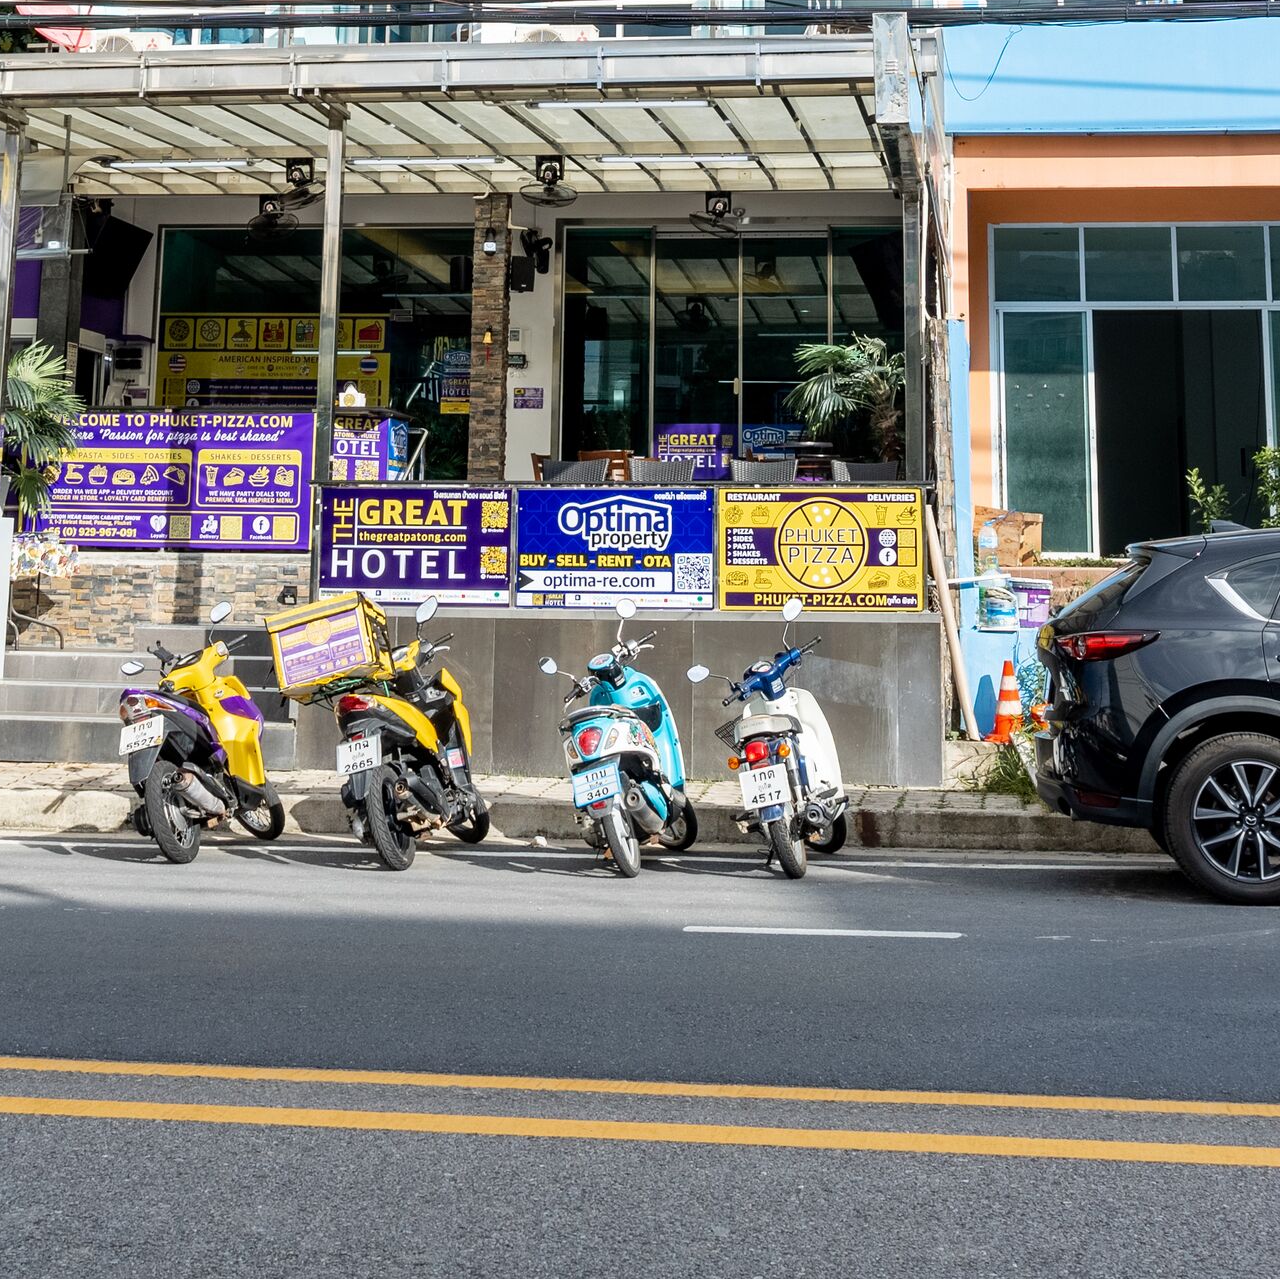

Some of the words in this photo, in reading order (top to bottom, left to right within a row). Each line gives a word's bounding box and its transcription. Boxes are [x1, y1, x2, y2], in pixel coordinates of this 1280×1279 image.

[263, 356, 301, 364] INSPIRED
[125, 414, 145, 427] TO
[150, 414, 293, 428] PHUKET-PIZZA.COM
[334, 417, 381, 431] GREAT
[145, 429, 165, 445] for
[166, 431, 198, 445] pizza
[200, 431, 211, 441] is
[214, 429, 237, 441] best
[670, 434, 716, 446] GREAT
[743, 430, 785, 442] Optima
[336, 440, 380, 455] OTEL
[658, 434, 668, 453] THE
[144, 452, 182, 460] TOASTIES
[727, 494, 781, 502] RESTAURANT
[867, 494, 915, 502] DELIVERIES
[359, 499, 468, 526] GREAT
[332, 498, 354, 543] THE
[560, 505, 669, 537] Optima
[62, 527, 77, 537] (0)
[78, 527, 137, 538] 929-967-091
[359, 531, 467, 543] thegreatpatong.com
[784, 528, 858, 543] PHUKET
[591, 532, 668, 548] property
[520, 554, 547, 567] BUY
[556, 555, 587, 567] SELL
[598, 555, 634, 567] RENT
[643, 555, 672, 568] OTA
[788, 547, 855, 564] PIZZA
[331, 549, 466, 579] HOTEL
[543, 573, 655, 589] optima-re.com
[344, 758, 373, 772] 2665
[587, 787, 609, 801] 340
[752, 790, 781, 804] 4517
